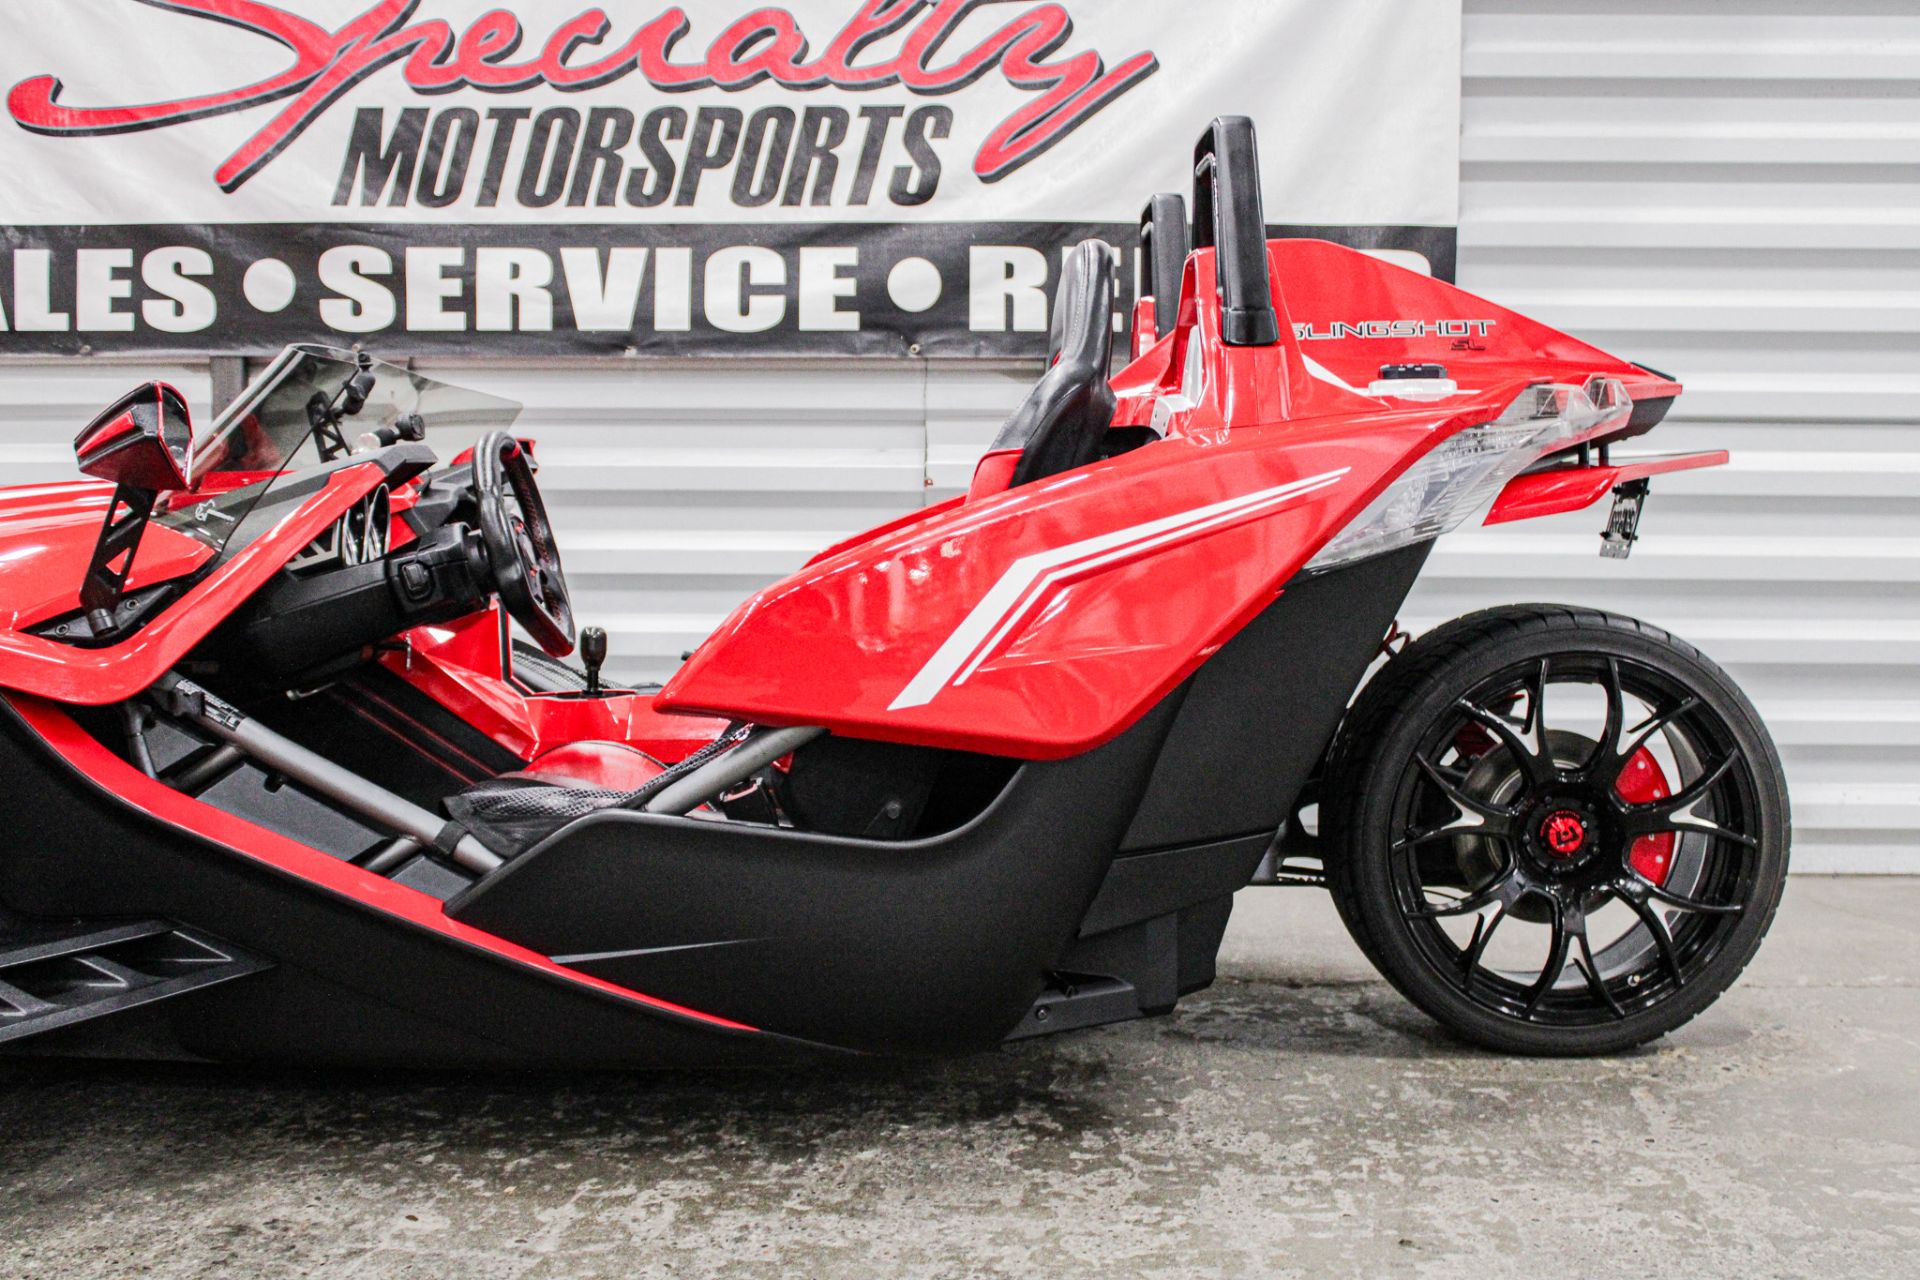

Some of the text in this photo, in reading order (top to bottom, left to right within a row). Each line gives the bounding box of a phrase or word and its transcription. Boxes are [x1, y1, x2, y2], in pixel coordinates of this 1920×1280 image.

[331, 105, 954, 208] MOTORSPORTS
[0, 245, 861, 333] LES SERVICE
